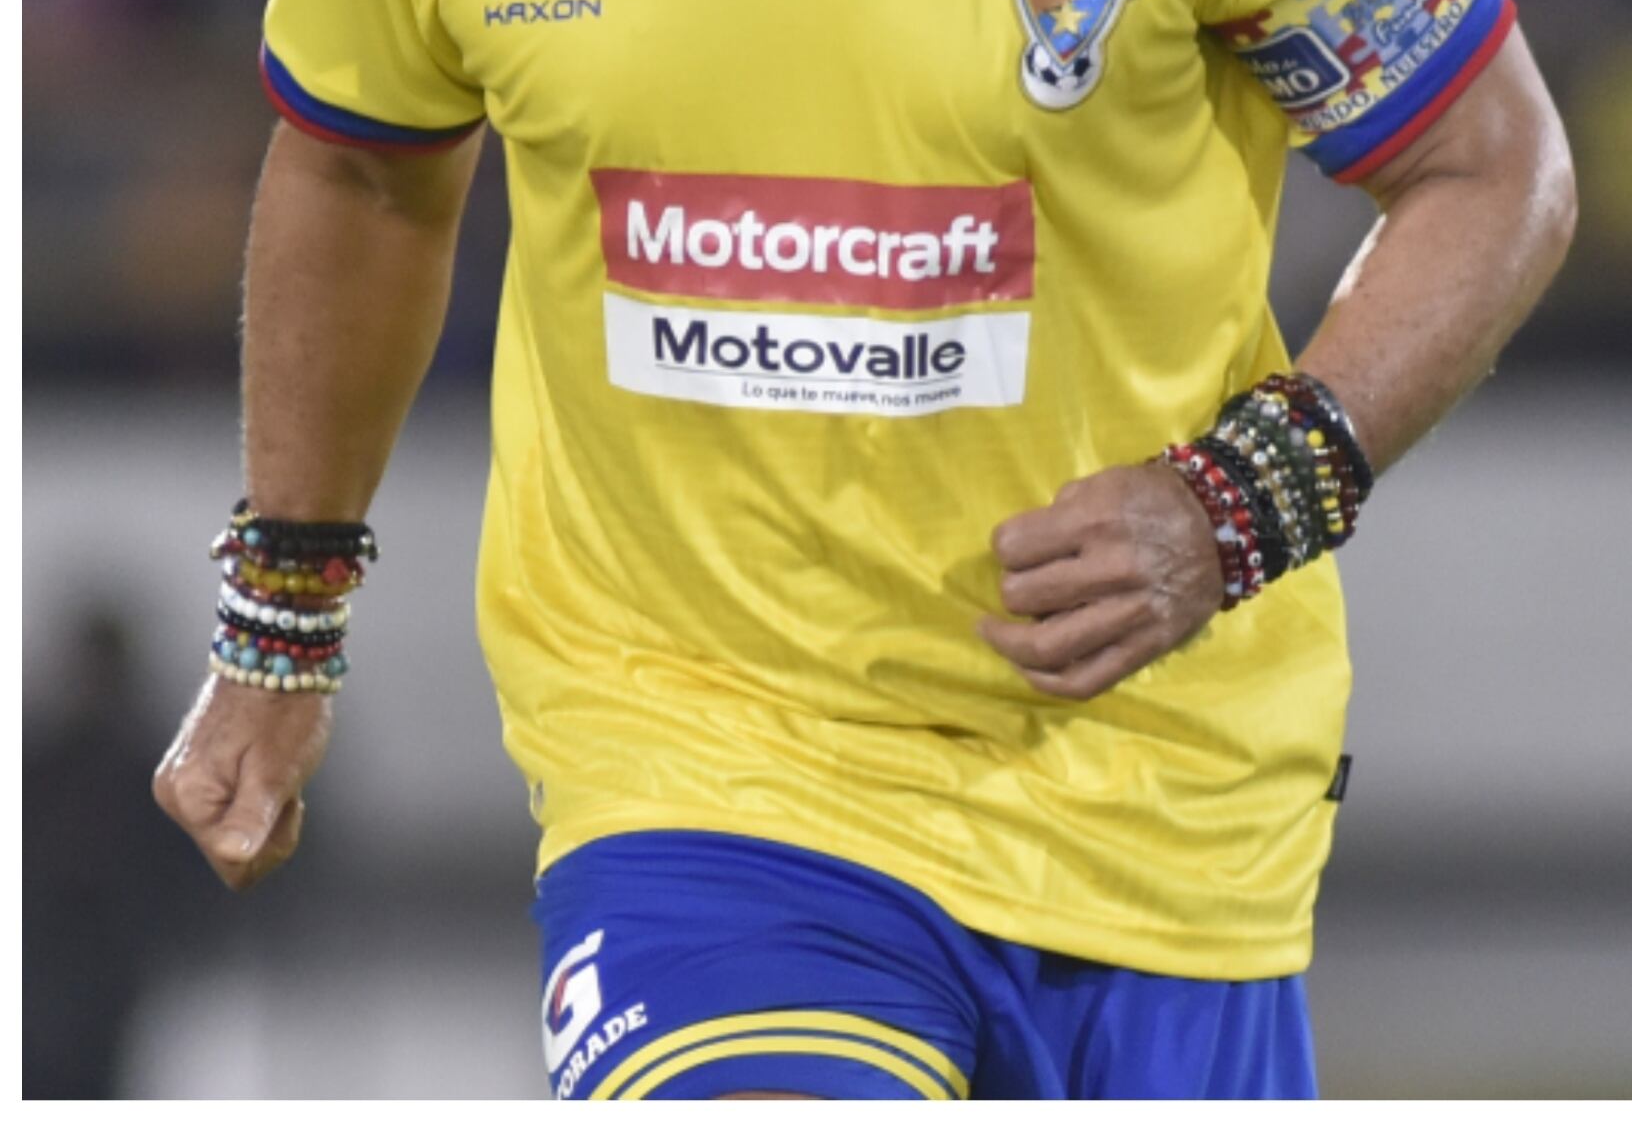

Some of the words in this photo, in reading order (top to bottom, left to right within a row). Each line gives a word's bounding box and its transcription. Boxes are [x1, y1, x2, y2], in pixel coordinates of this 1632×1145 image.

[626, 198, 998, 282] Motorcraft
[651, 315, 968, 381] Motovalle
[767, 384, 797, 403] que
[557, 1001, 648, 1100] ORADE
